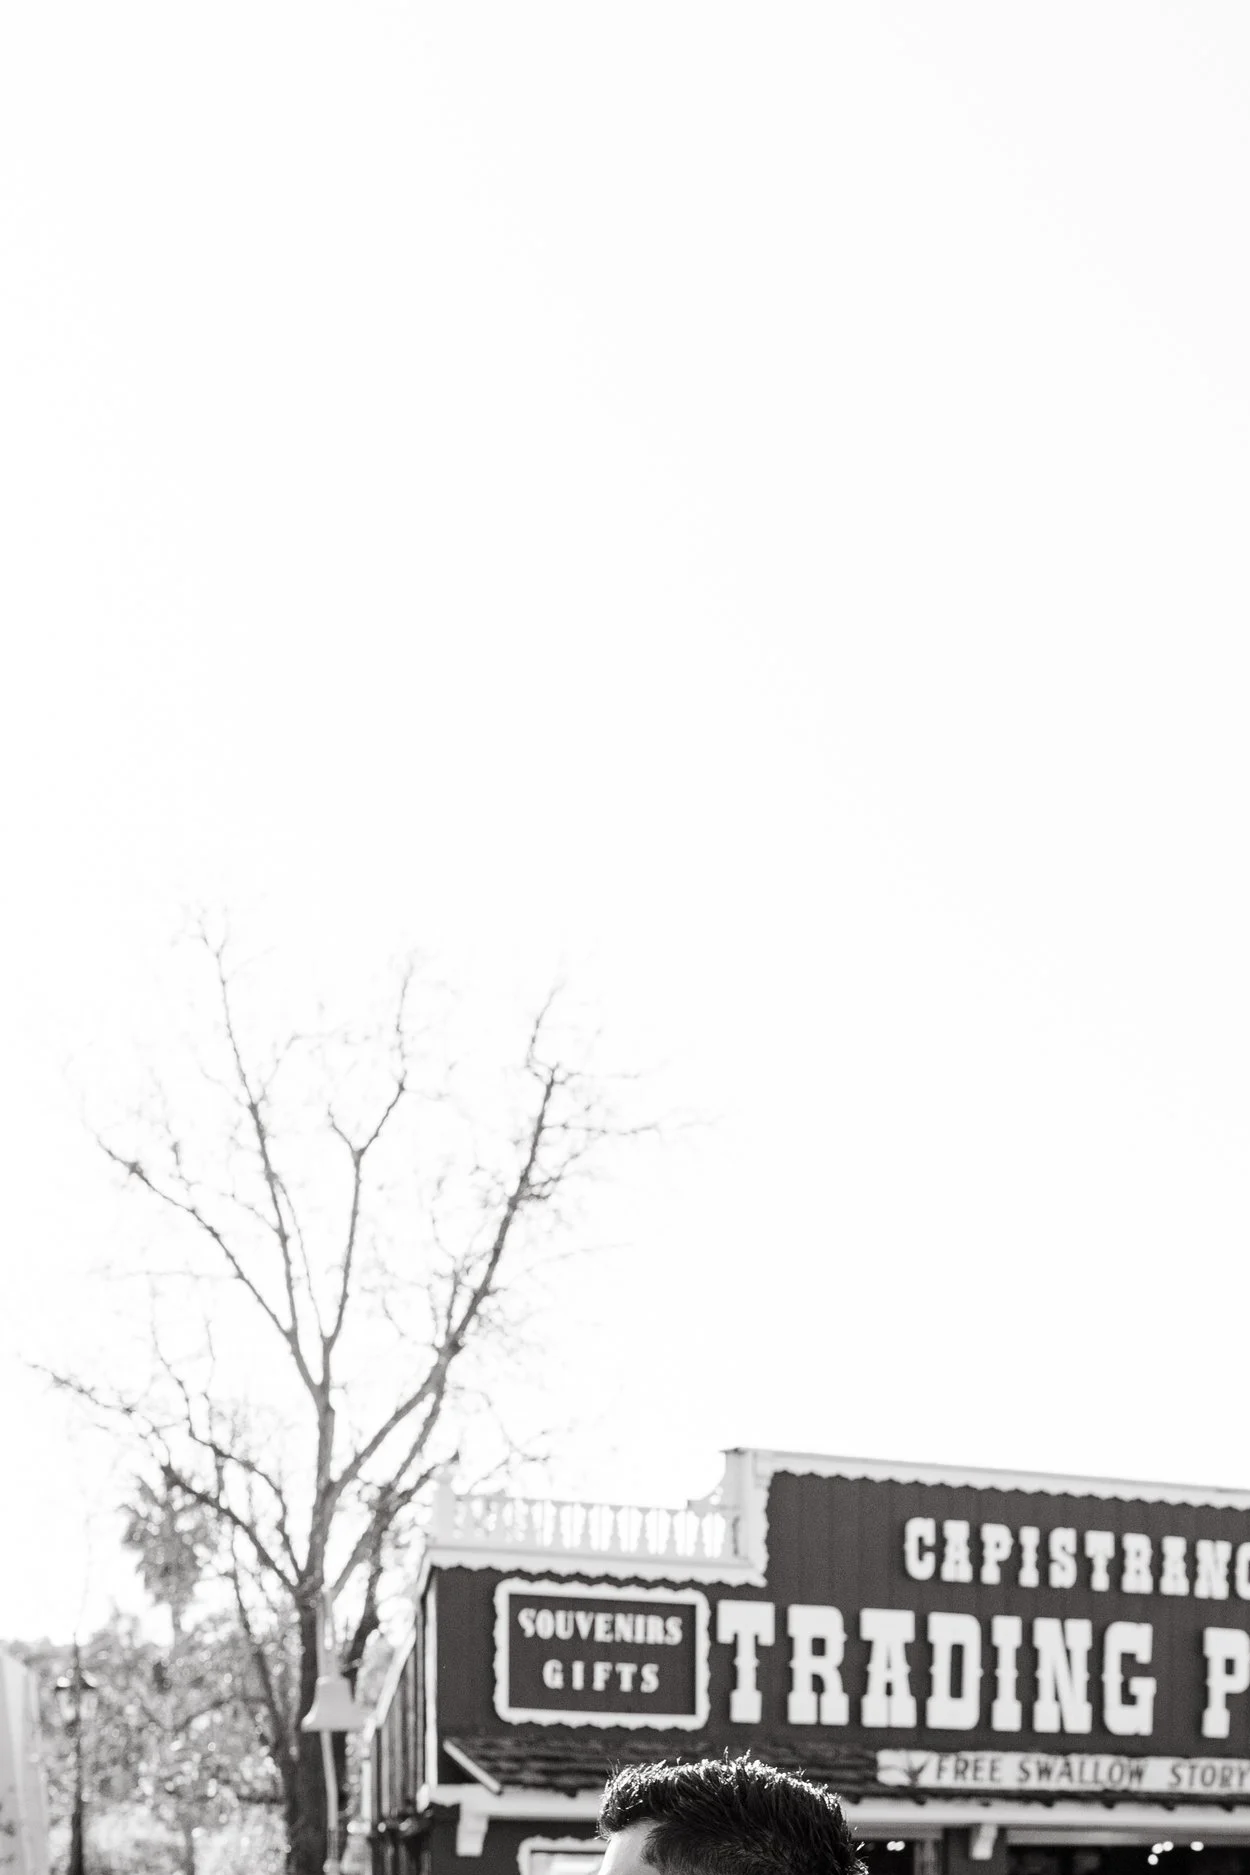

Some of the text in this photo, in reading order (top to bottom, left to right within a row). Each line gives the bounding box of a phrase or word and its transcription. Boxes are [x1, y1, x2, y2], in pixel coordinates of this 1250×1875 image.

[517, 1607, 684, 1646] SOUVENIRS
[542, 1658, 660, 1694] GIFTS
[717, 1599, 1157, 1736] TRADING
[936, 1756, 1247, 1789] FREE SWALLOW STORY
